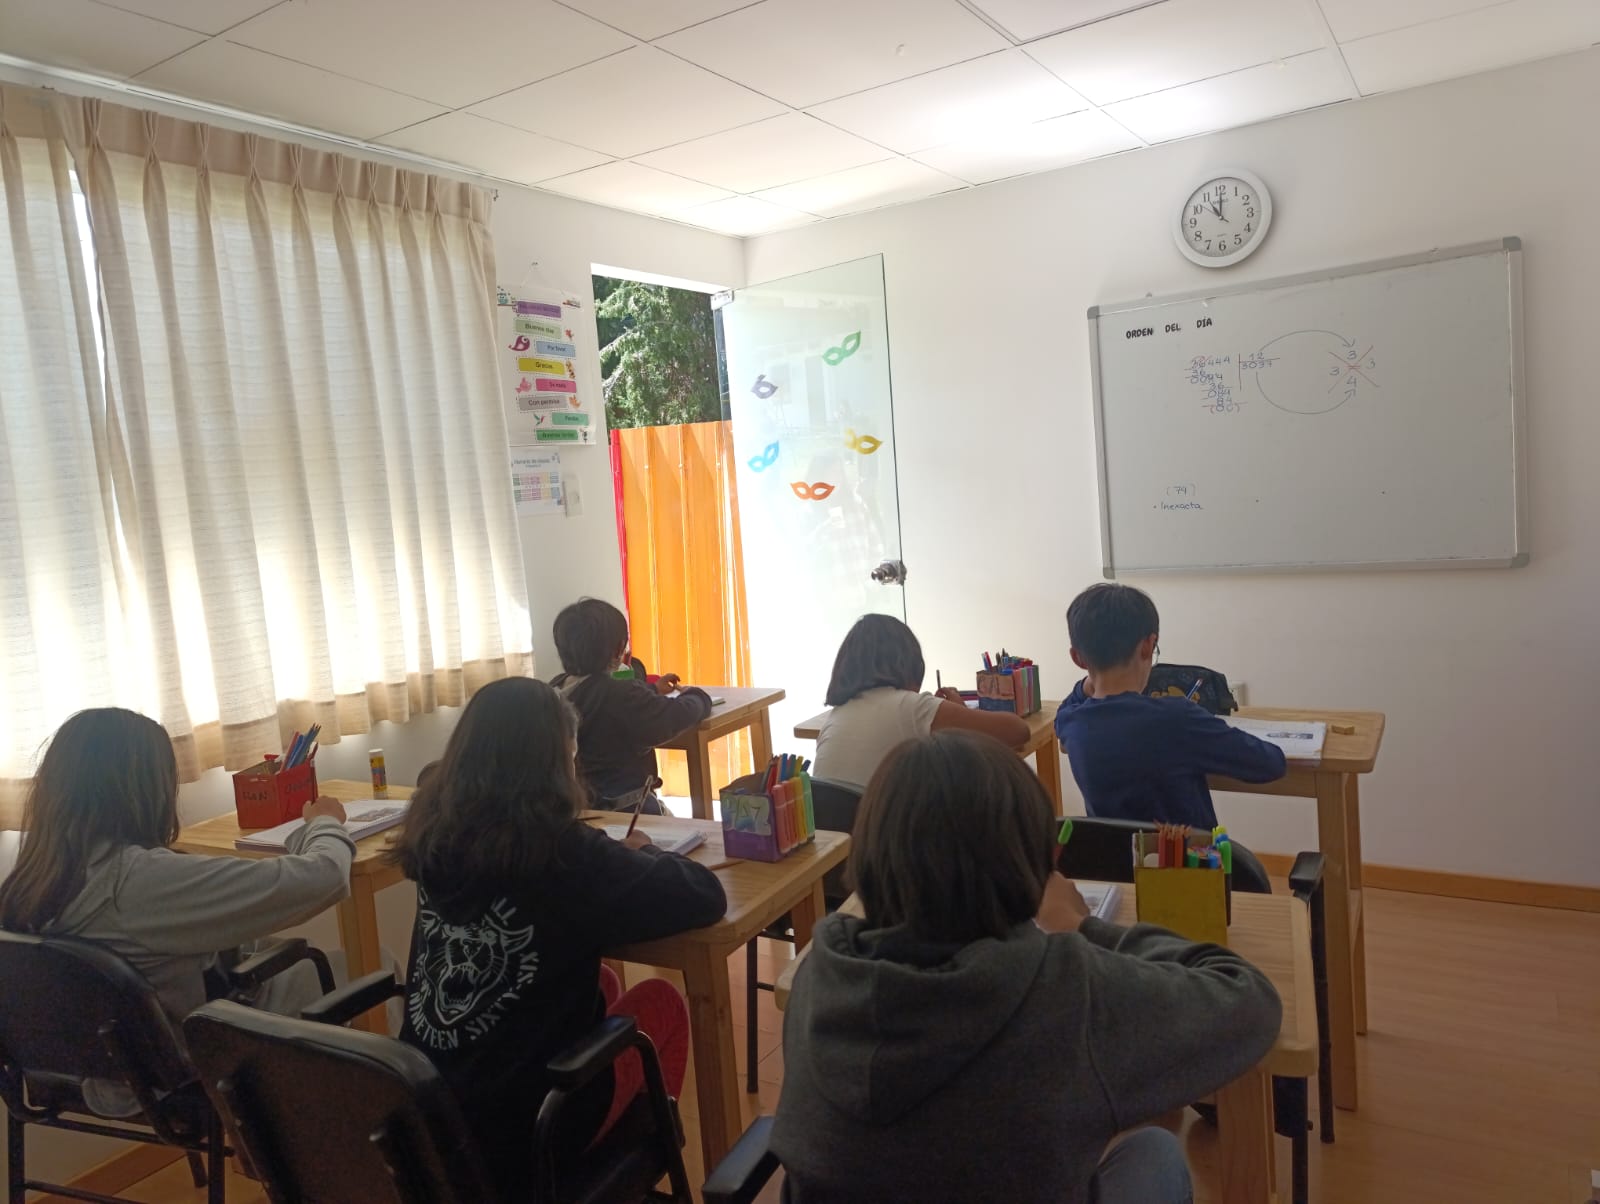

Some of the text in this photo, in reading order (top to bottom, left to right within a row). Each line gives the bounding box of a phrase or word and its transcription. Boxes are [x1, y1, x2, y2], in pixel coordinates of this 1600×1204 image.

[1215, 185, 1226, 196] 12
[1203, 192, 1210, 202] 11
[1242, 195, 1250, 205] 2
[1193, 204, 1203, 215] 10
[1246, 207, 1255, 218] 3
[1189, 217, 1197, 228] 9
[1244, 222, 1251, 232] 4
[1194, 231, 1202, 241] 8
[1234, 234, 1242, 245] 5
[1204, 240, 1212, 250] 7
[1219, 240, 1227, 251] 6
[1125, 316, 1213, 339] ORDEN DEL DÍA
[1347, 350, 1357, 360] 3
[1329, 367, 1340, 376] 3
[408, 991, 460, 1050] NINETEEN
